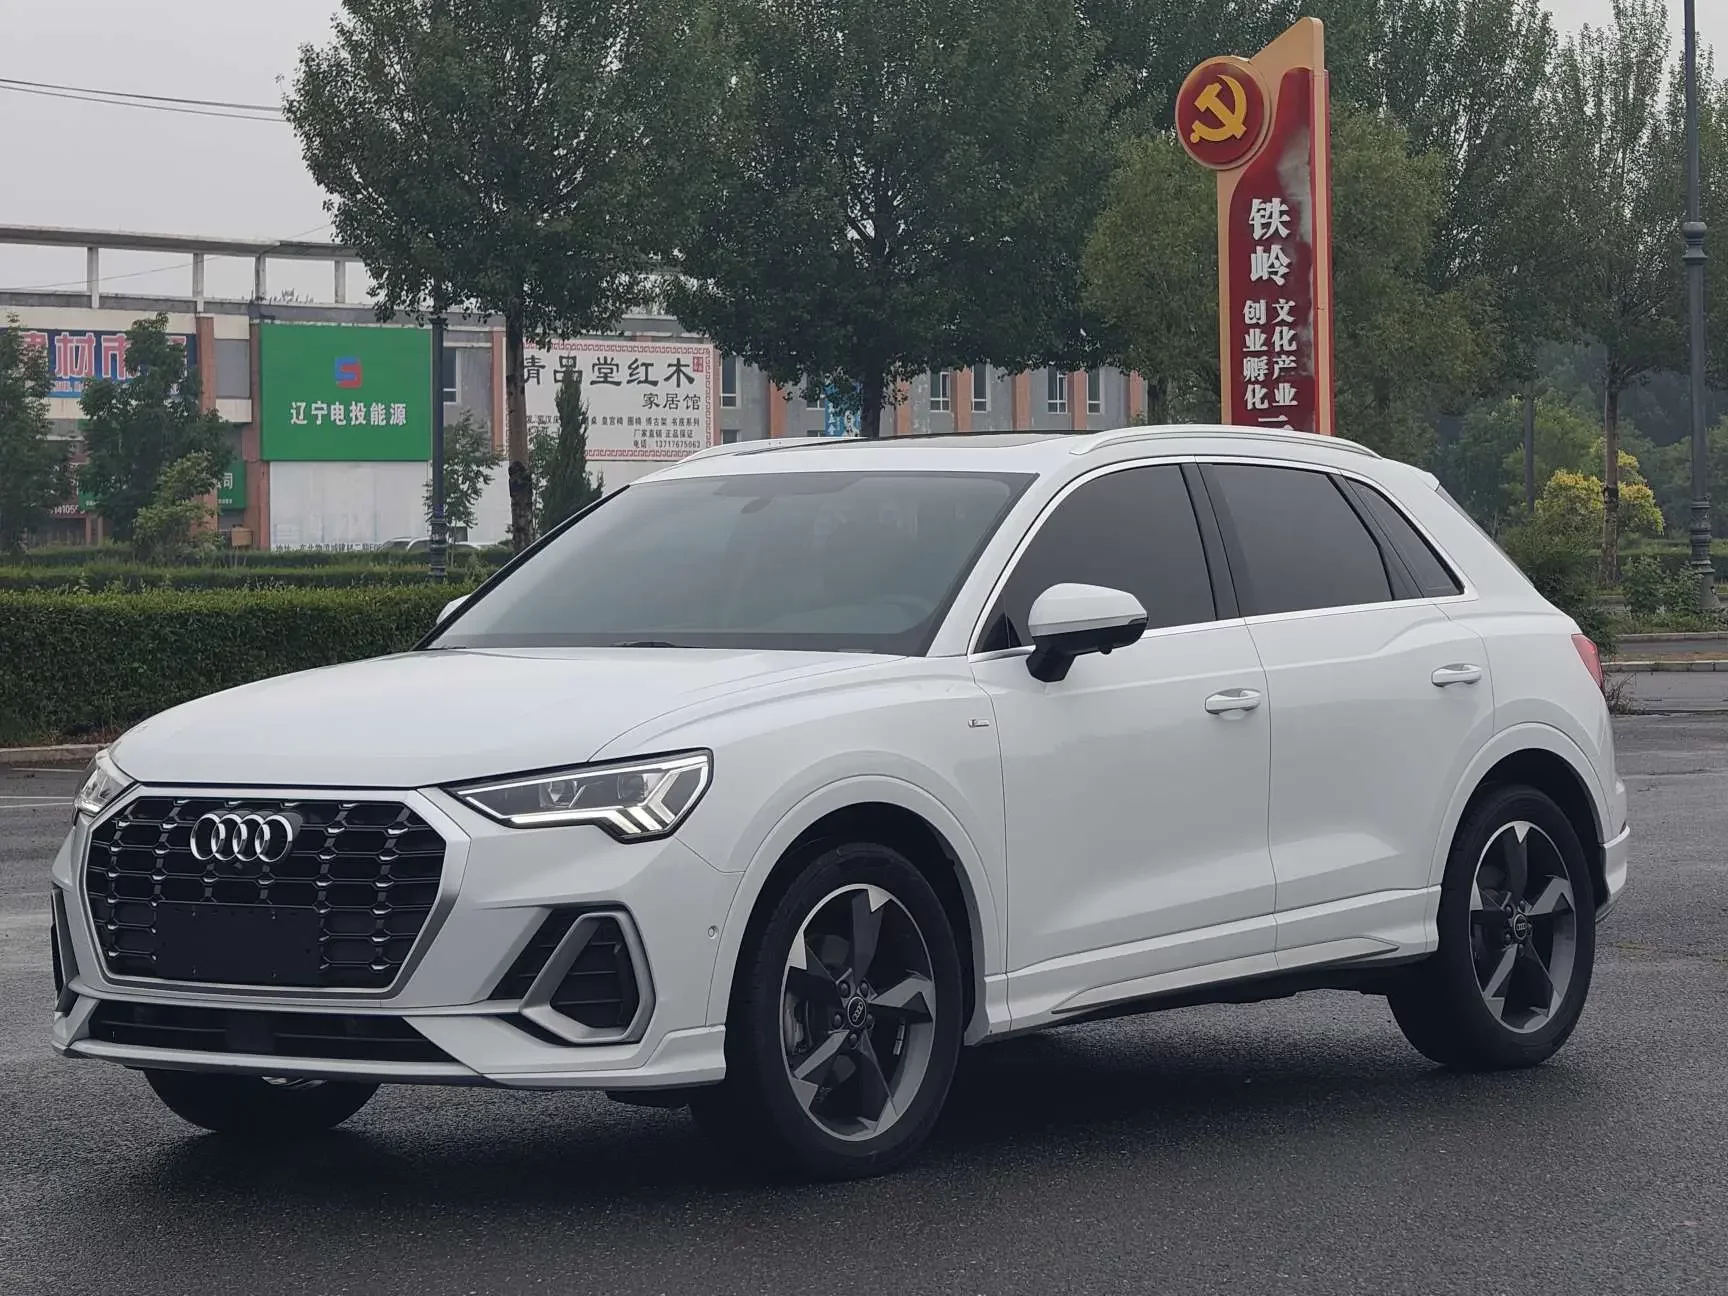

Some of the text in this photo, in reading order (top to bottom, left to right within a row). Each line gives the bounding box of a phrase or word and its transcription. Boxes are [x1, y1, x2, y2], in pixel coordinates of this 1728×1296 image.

[1249, 198, 1291, 286] 铁岭
[1242, 300, 1269, 410] 创业孵化
[1271, 299, 1298, 406] 文化产业
[290, 401, 407, 426] 辽宁电投能源
[641, 393, 701, 411] 家居馆
[665, 429, 693, 439] 正品保证
